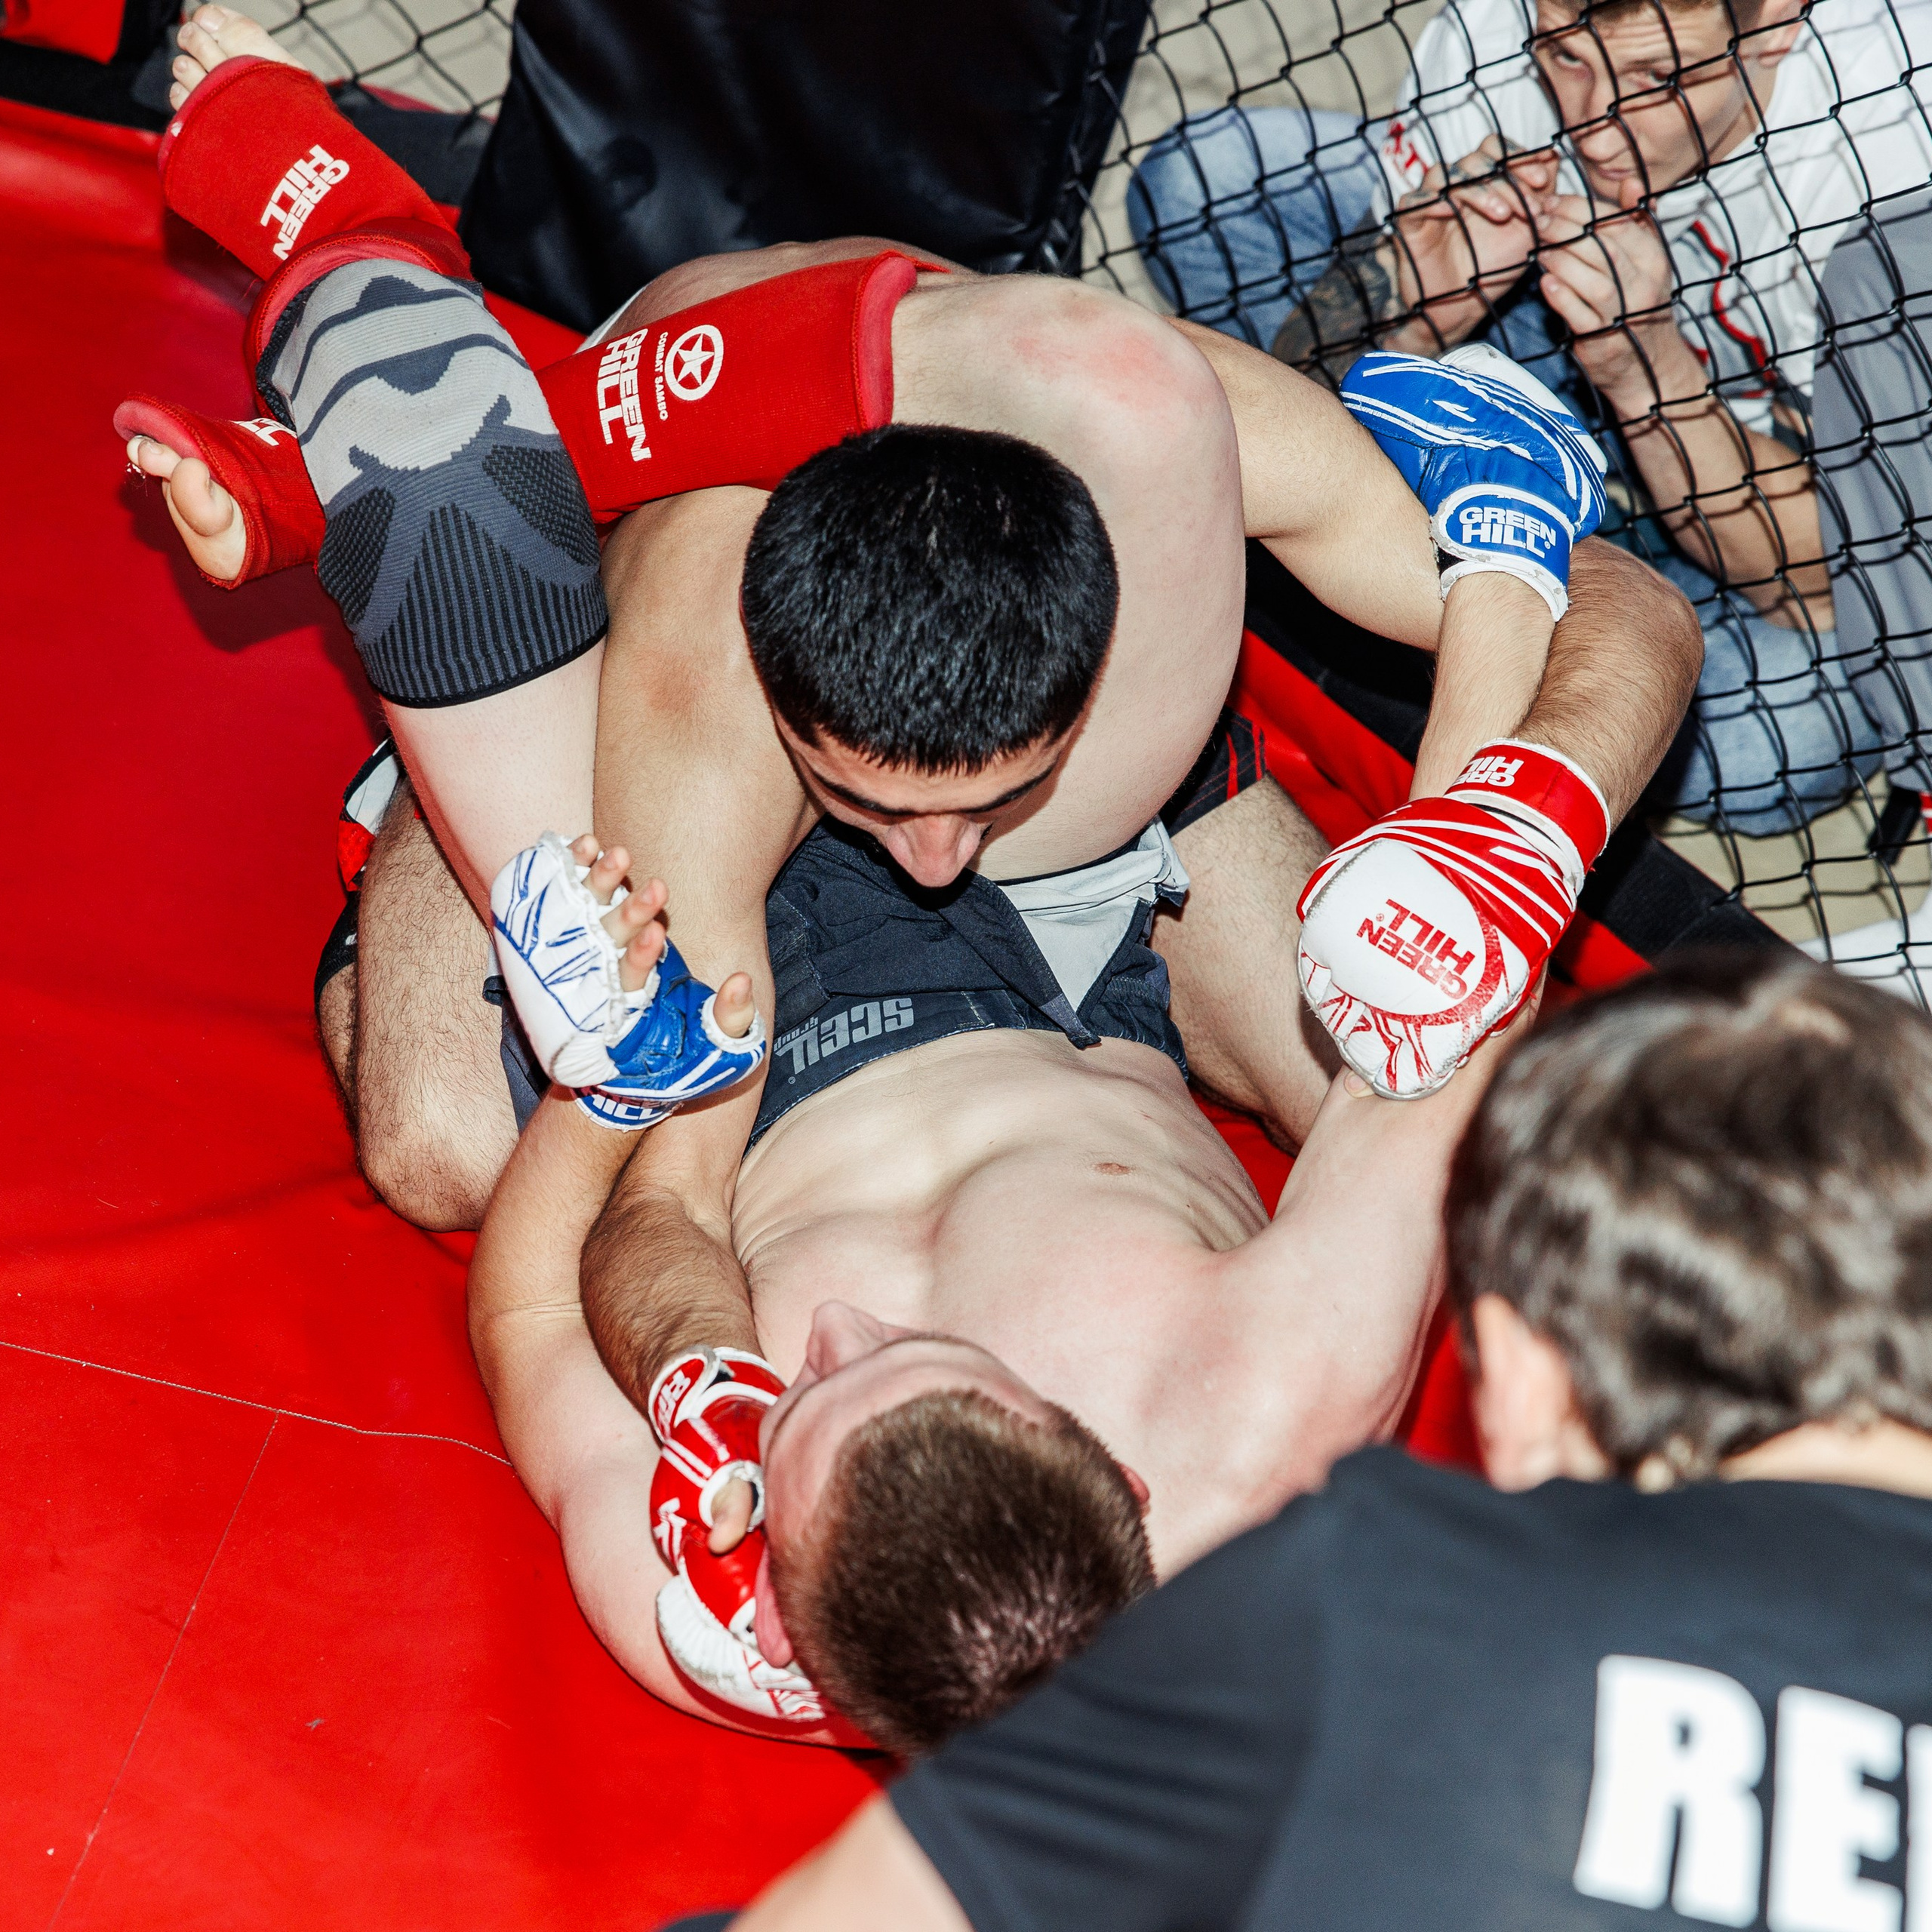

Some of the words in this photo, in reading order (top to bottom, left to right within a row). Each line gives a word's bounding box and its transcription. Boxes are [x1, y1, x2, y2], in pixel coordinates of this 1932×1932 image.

[260, 144, 334, 227] HILL
[272, 159, 350, 261] GREEN
[597, 336, 633, 445] HILL
[654, 331, 669, 373] COMBAT
[620, 328, 652, 462] GREEN
[654, 376, 669, 421] SAMBO
[1459, 506, 1556, 546] GREEN
[1462, 522, 1546, 558] HILL
[1356, 918, 1468, 1000] GREEN
[1386, 899, 1475, 976] HILL
[1572, 1654, 1932, 1932] RE
